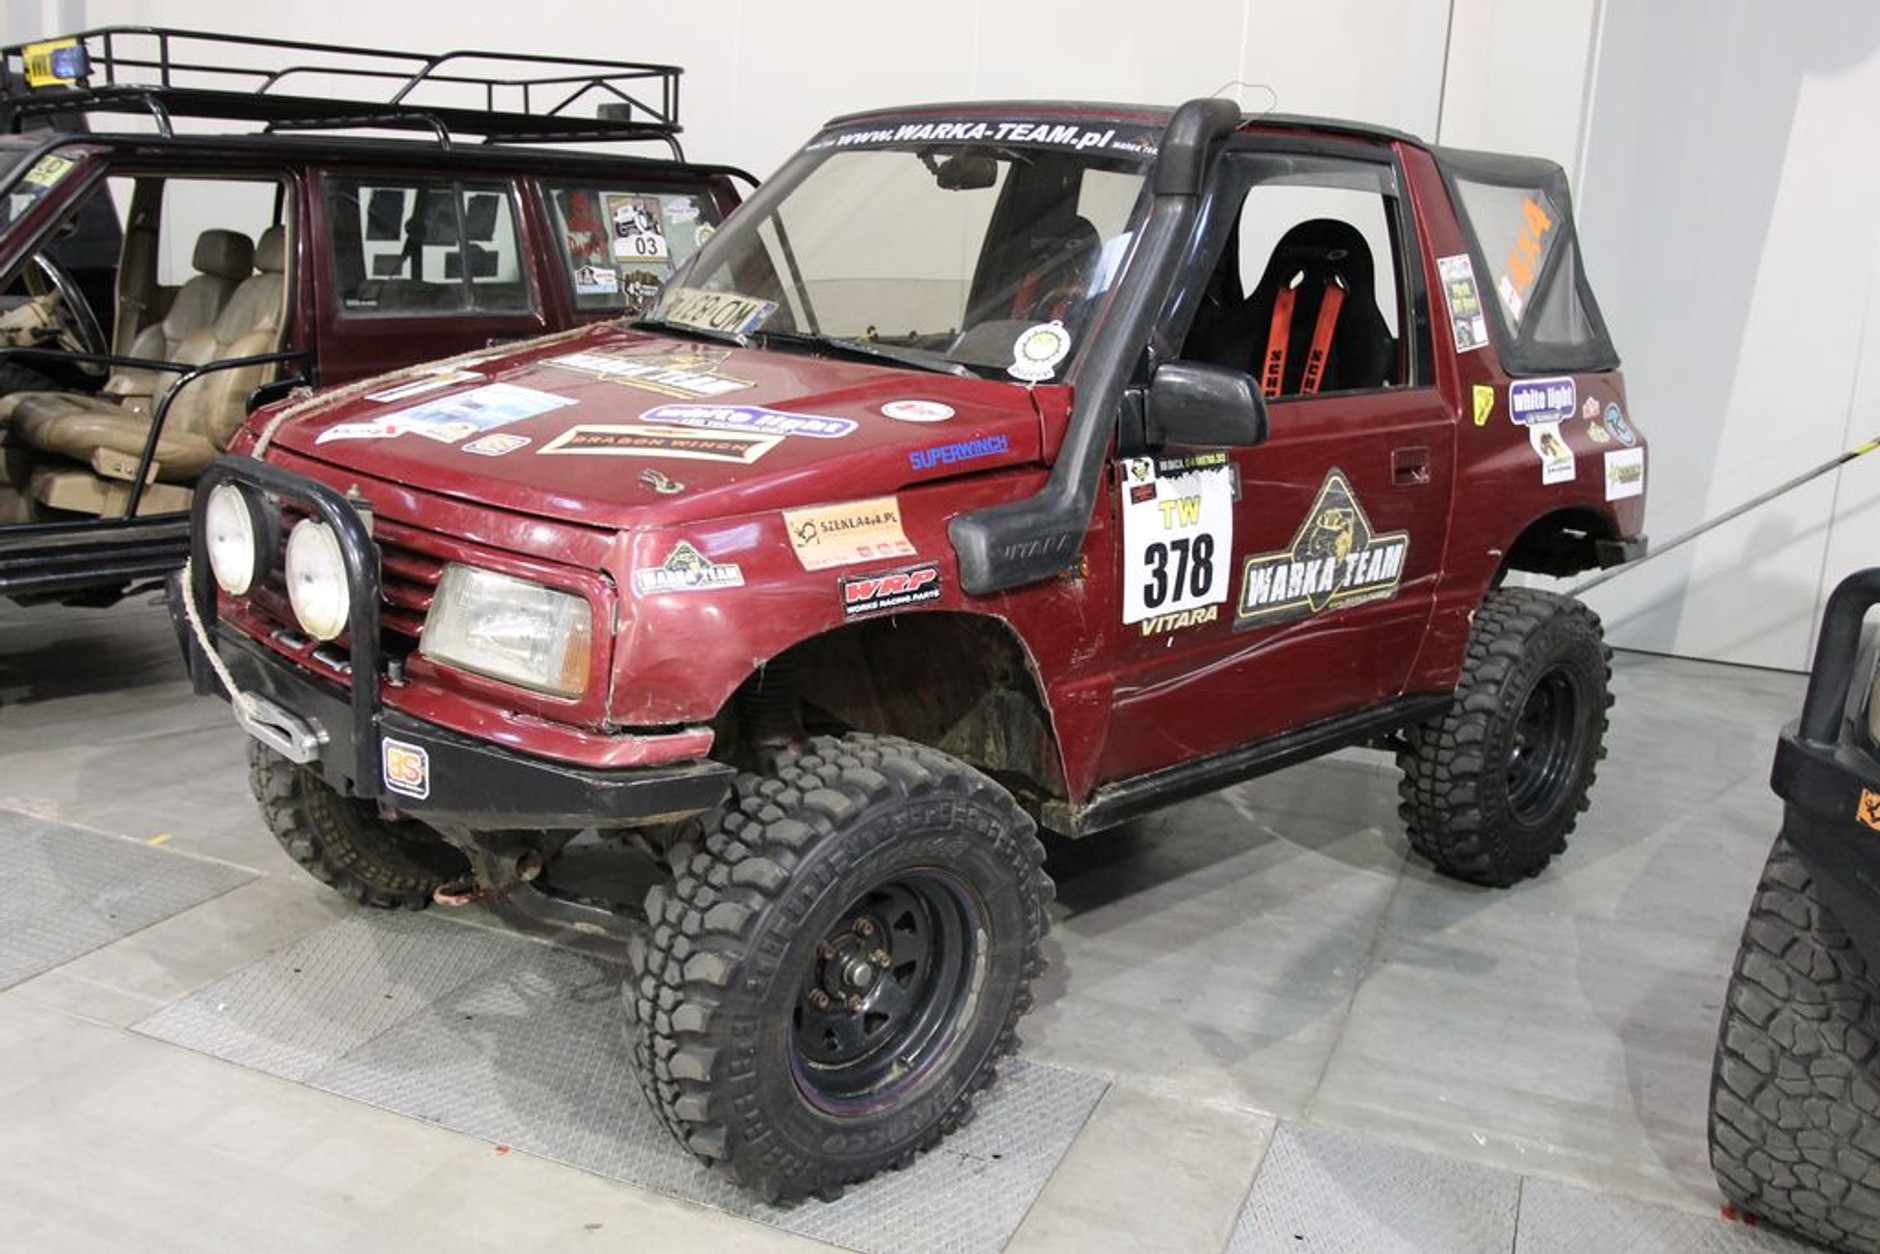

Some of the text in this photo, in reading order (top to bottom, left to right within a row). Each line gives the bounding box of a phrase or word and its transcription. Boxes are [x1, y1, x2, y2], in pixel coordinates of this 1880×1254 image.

[837, 122, 1115, 150] www.WARKA-TEAM.pl
[635, 237, 659, 255] 03
[1513, 385, 1573, 412] white light
[572, 434, 748, 451] DRAGON WINCH
[909, 434, 1010, 471] SUPERWINCH
[1159, 495, 1202, 529] TW
[700, 566, 740, 582] TEAM
[845, 569, 938, 604] WRP
[1143, 533, 1215, 609] 378
[1247, 543, 1404, 607] WARKA TEAM
[1141, 605, 1219, 637] VITARA
